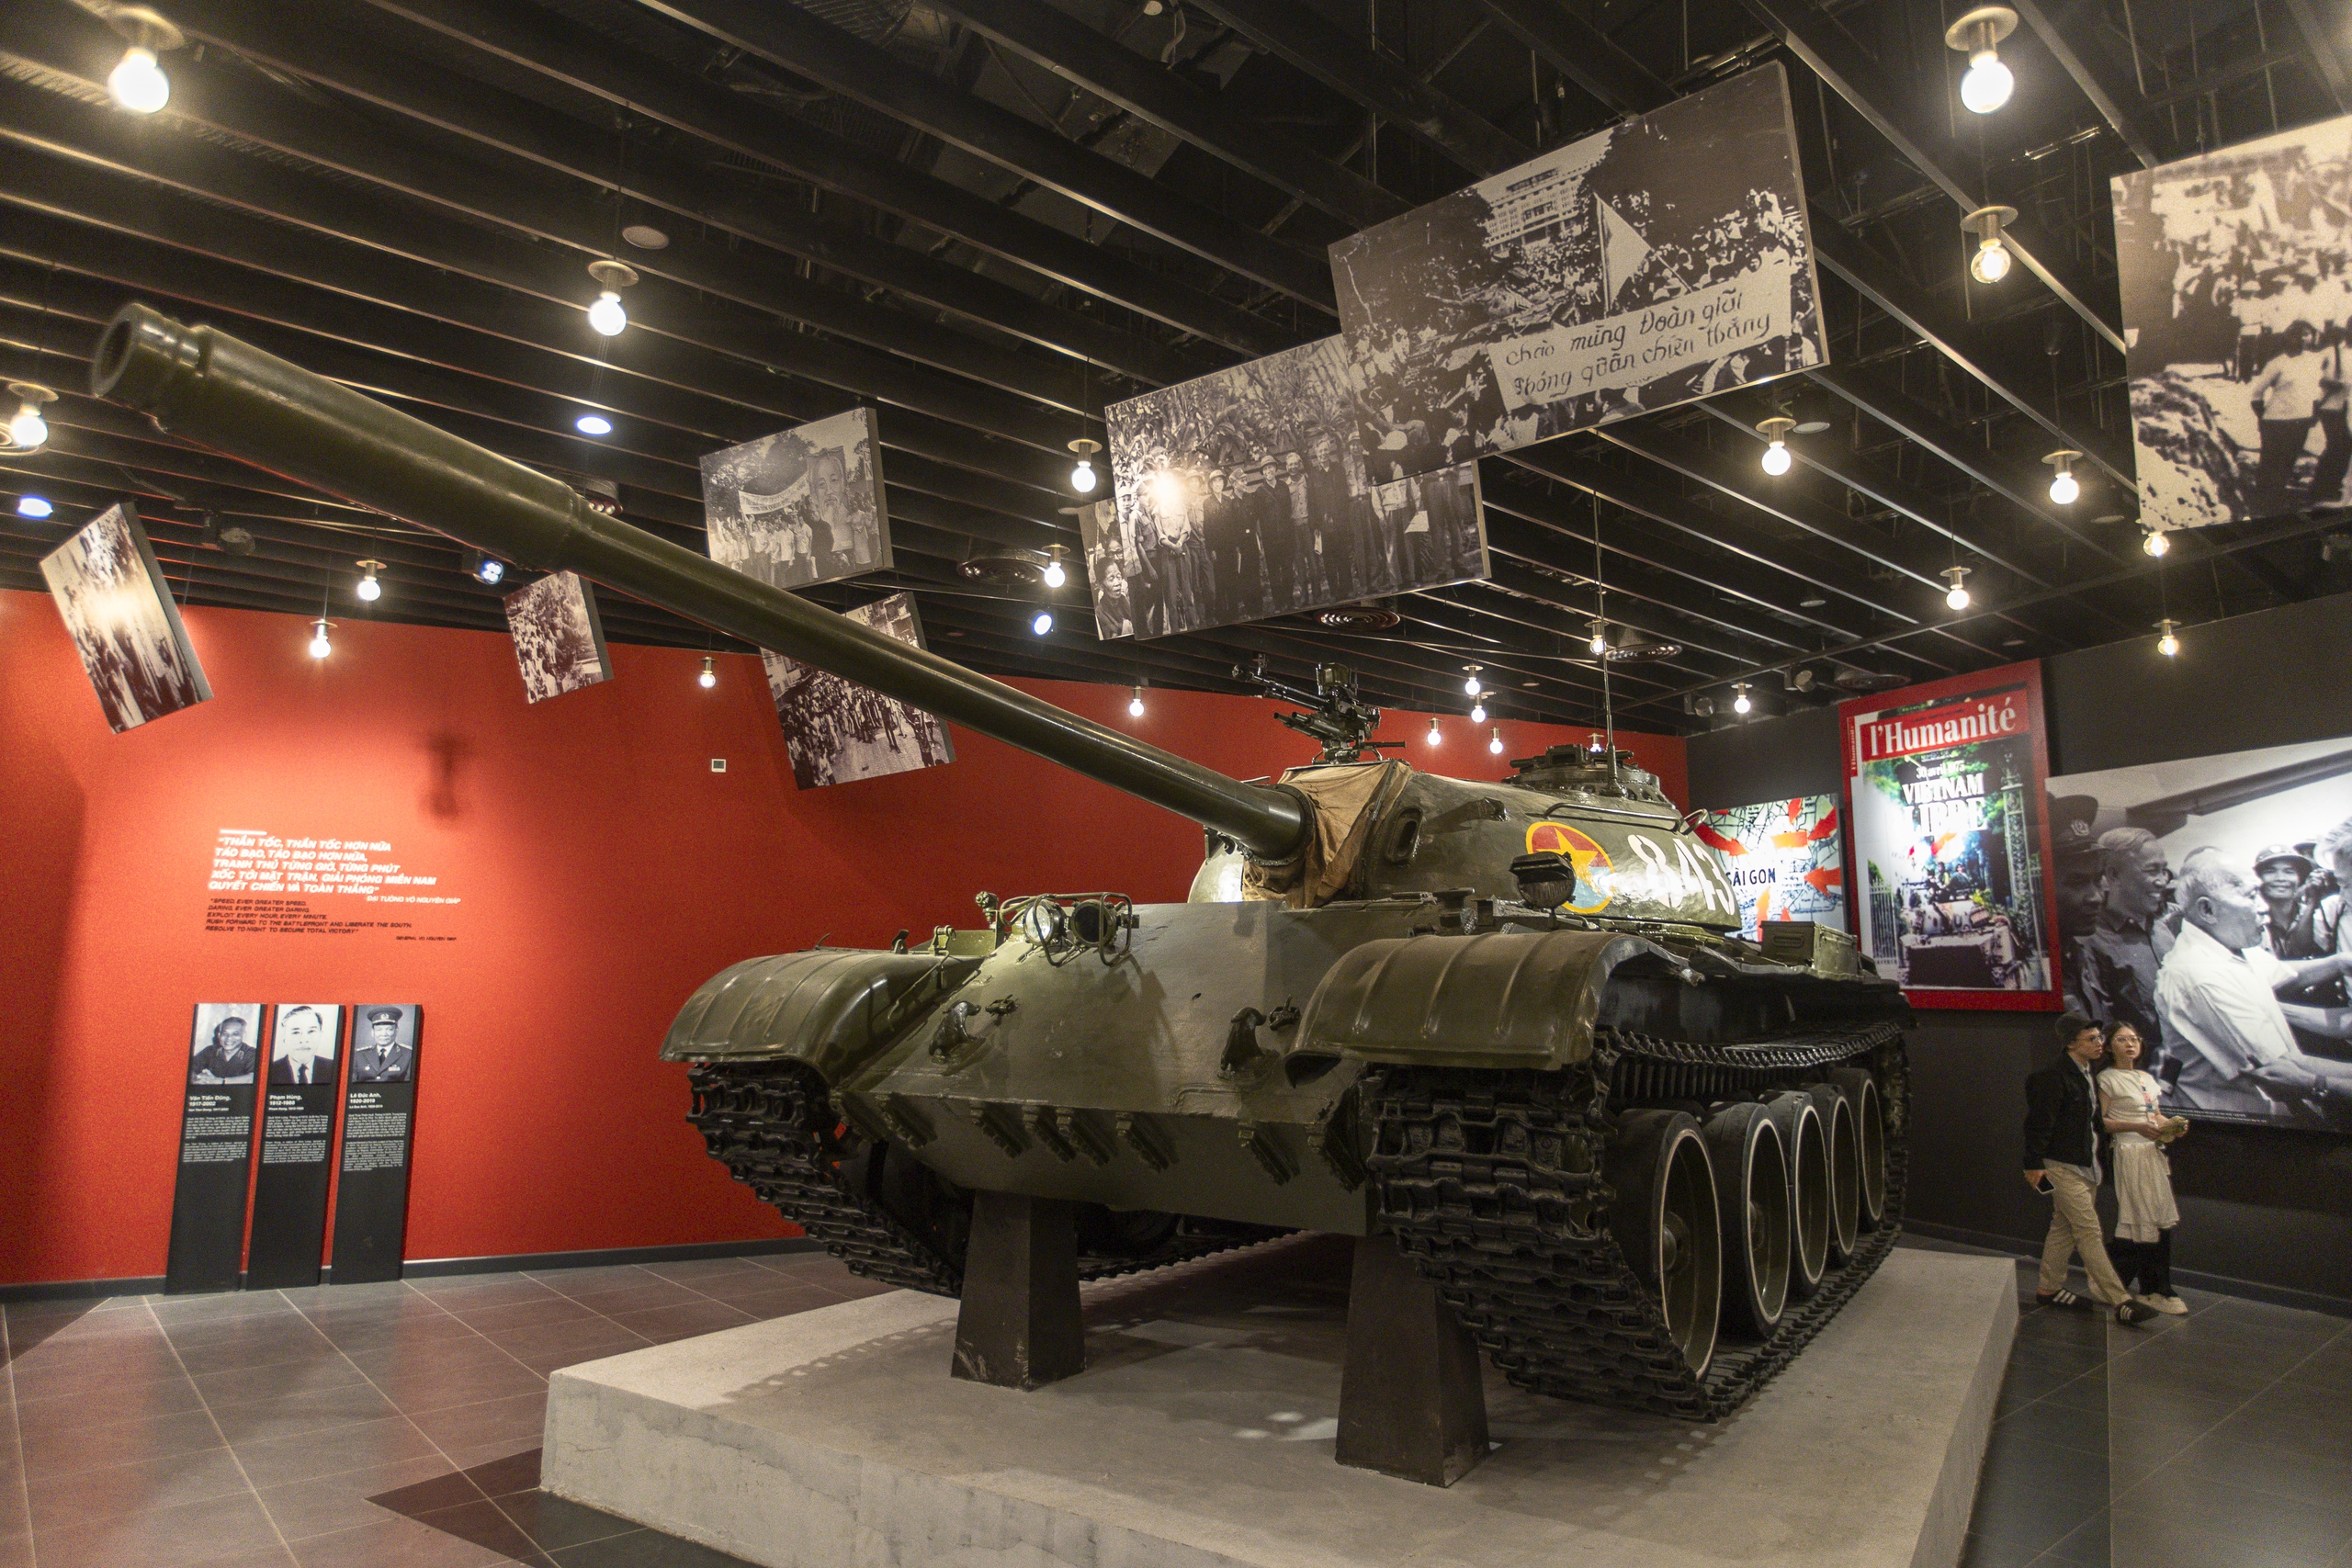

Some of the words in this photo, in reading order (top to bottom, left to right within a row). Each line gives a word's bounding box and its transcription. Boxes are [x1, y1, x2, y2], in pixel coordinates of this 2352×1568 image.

[1639, 305, 1695, 335] Đoàn
[1869, 695, 2017, 757] l'Humanité
[1916, 765, 1928, 779] 30
[1927, 762, 1947, 778] avril
[1901, 772, 1985, 805] VIETNAM
[319, 838, 343, 850] TỐC
[215, 847, 239, 857] TÁO
[267, 849, 291, 859] TÁO
[213, 859, 254, 869] TRANH
[413, 876, 437, 886] NAM
[1627, 834, 1736, 916] 843
[287, 883, 301, 892] VÀ
[303, 882, 334, 893] TOÀN
